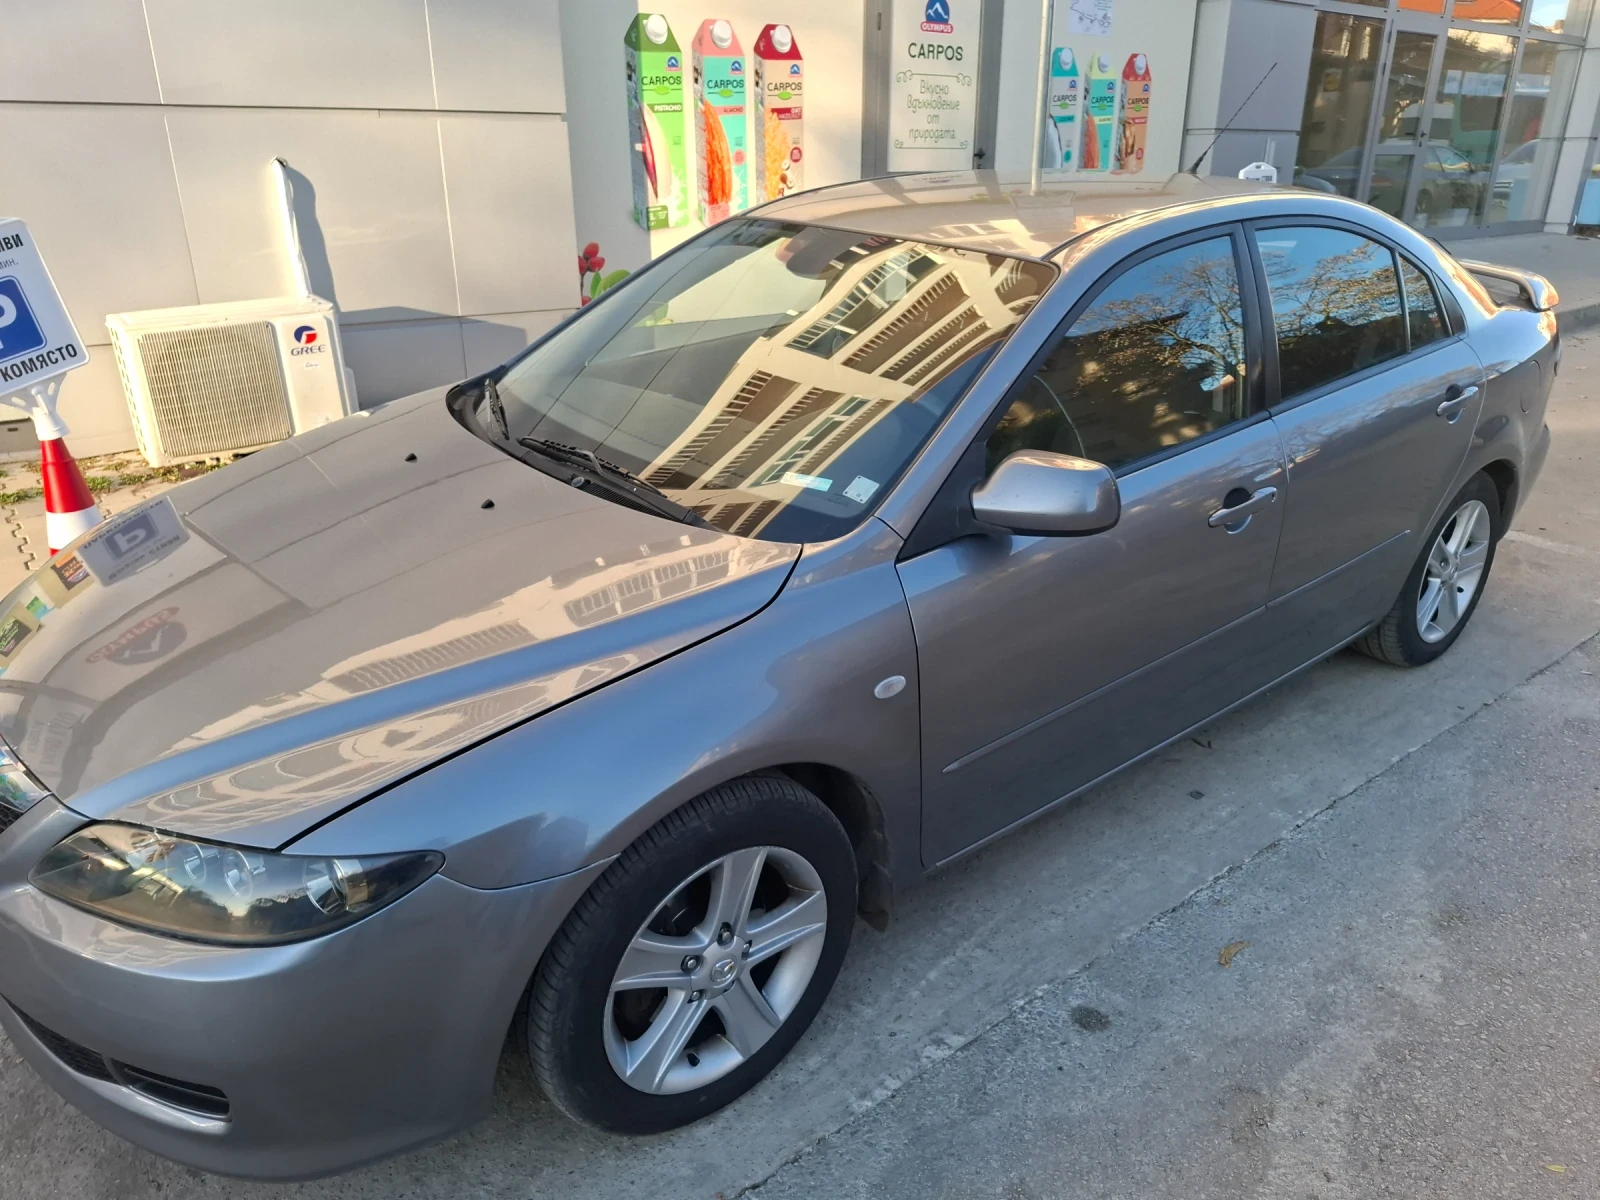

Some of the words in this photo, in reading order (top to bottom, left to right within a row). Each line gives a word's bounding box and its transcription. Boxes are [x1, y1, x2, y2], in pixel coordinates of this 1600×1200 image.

[922, 22, 952, 33] OLYMPUS
[908, 42, 964, 61] CARPOS
[641, 75, 682, 86] CARPOS
[706, 79, 745, 89] CARPOS
[767, 82, 803, 91] CARPOS
[920, 79, 949, 99] Вкусно
[1052, 94, 1077, 103] CARPOS
[1090, 96, 1115, 105] CARPOS
[1127, 97, 1149, 105] CARPOS
[291, 344, 326, 356] GREE
[0, 343, 78, 382] КОМЯСТО
